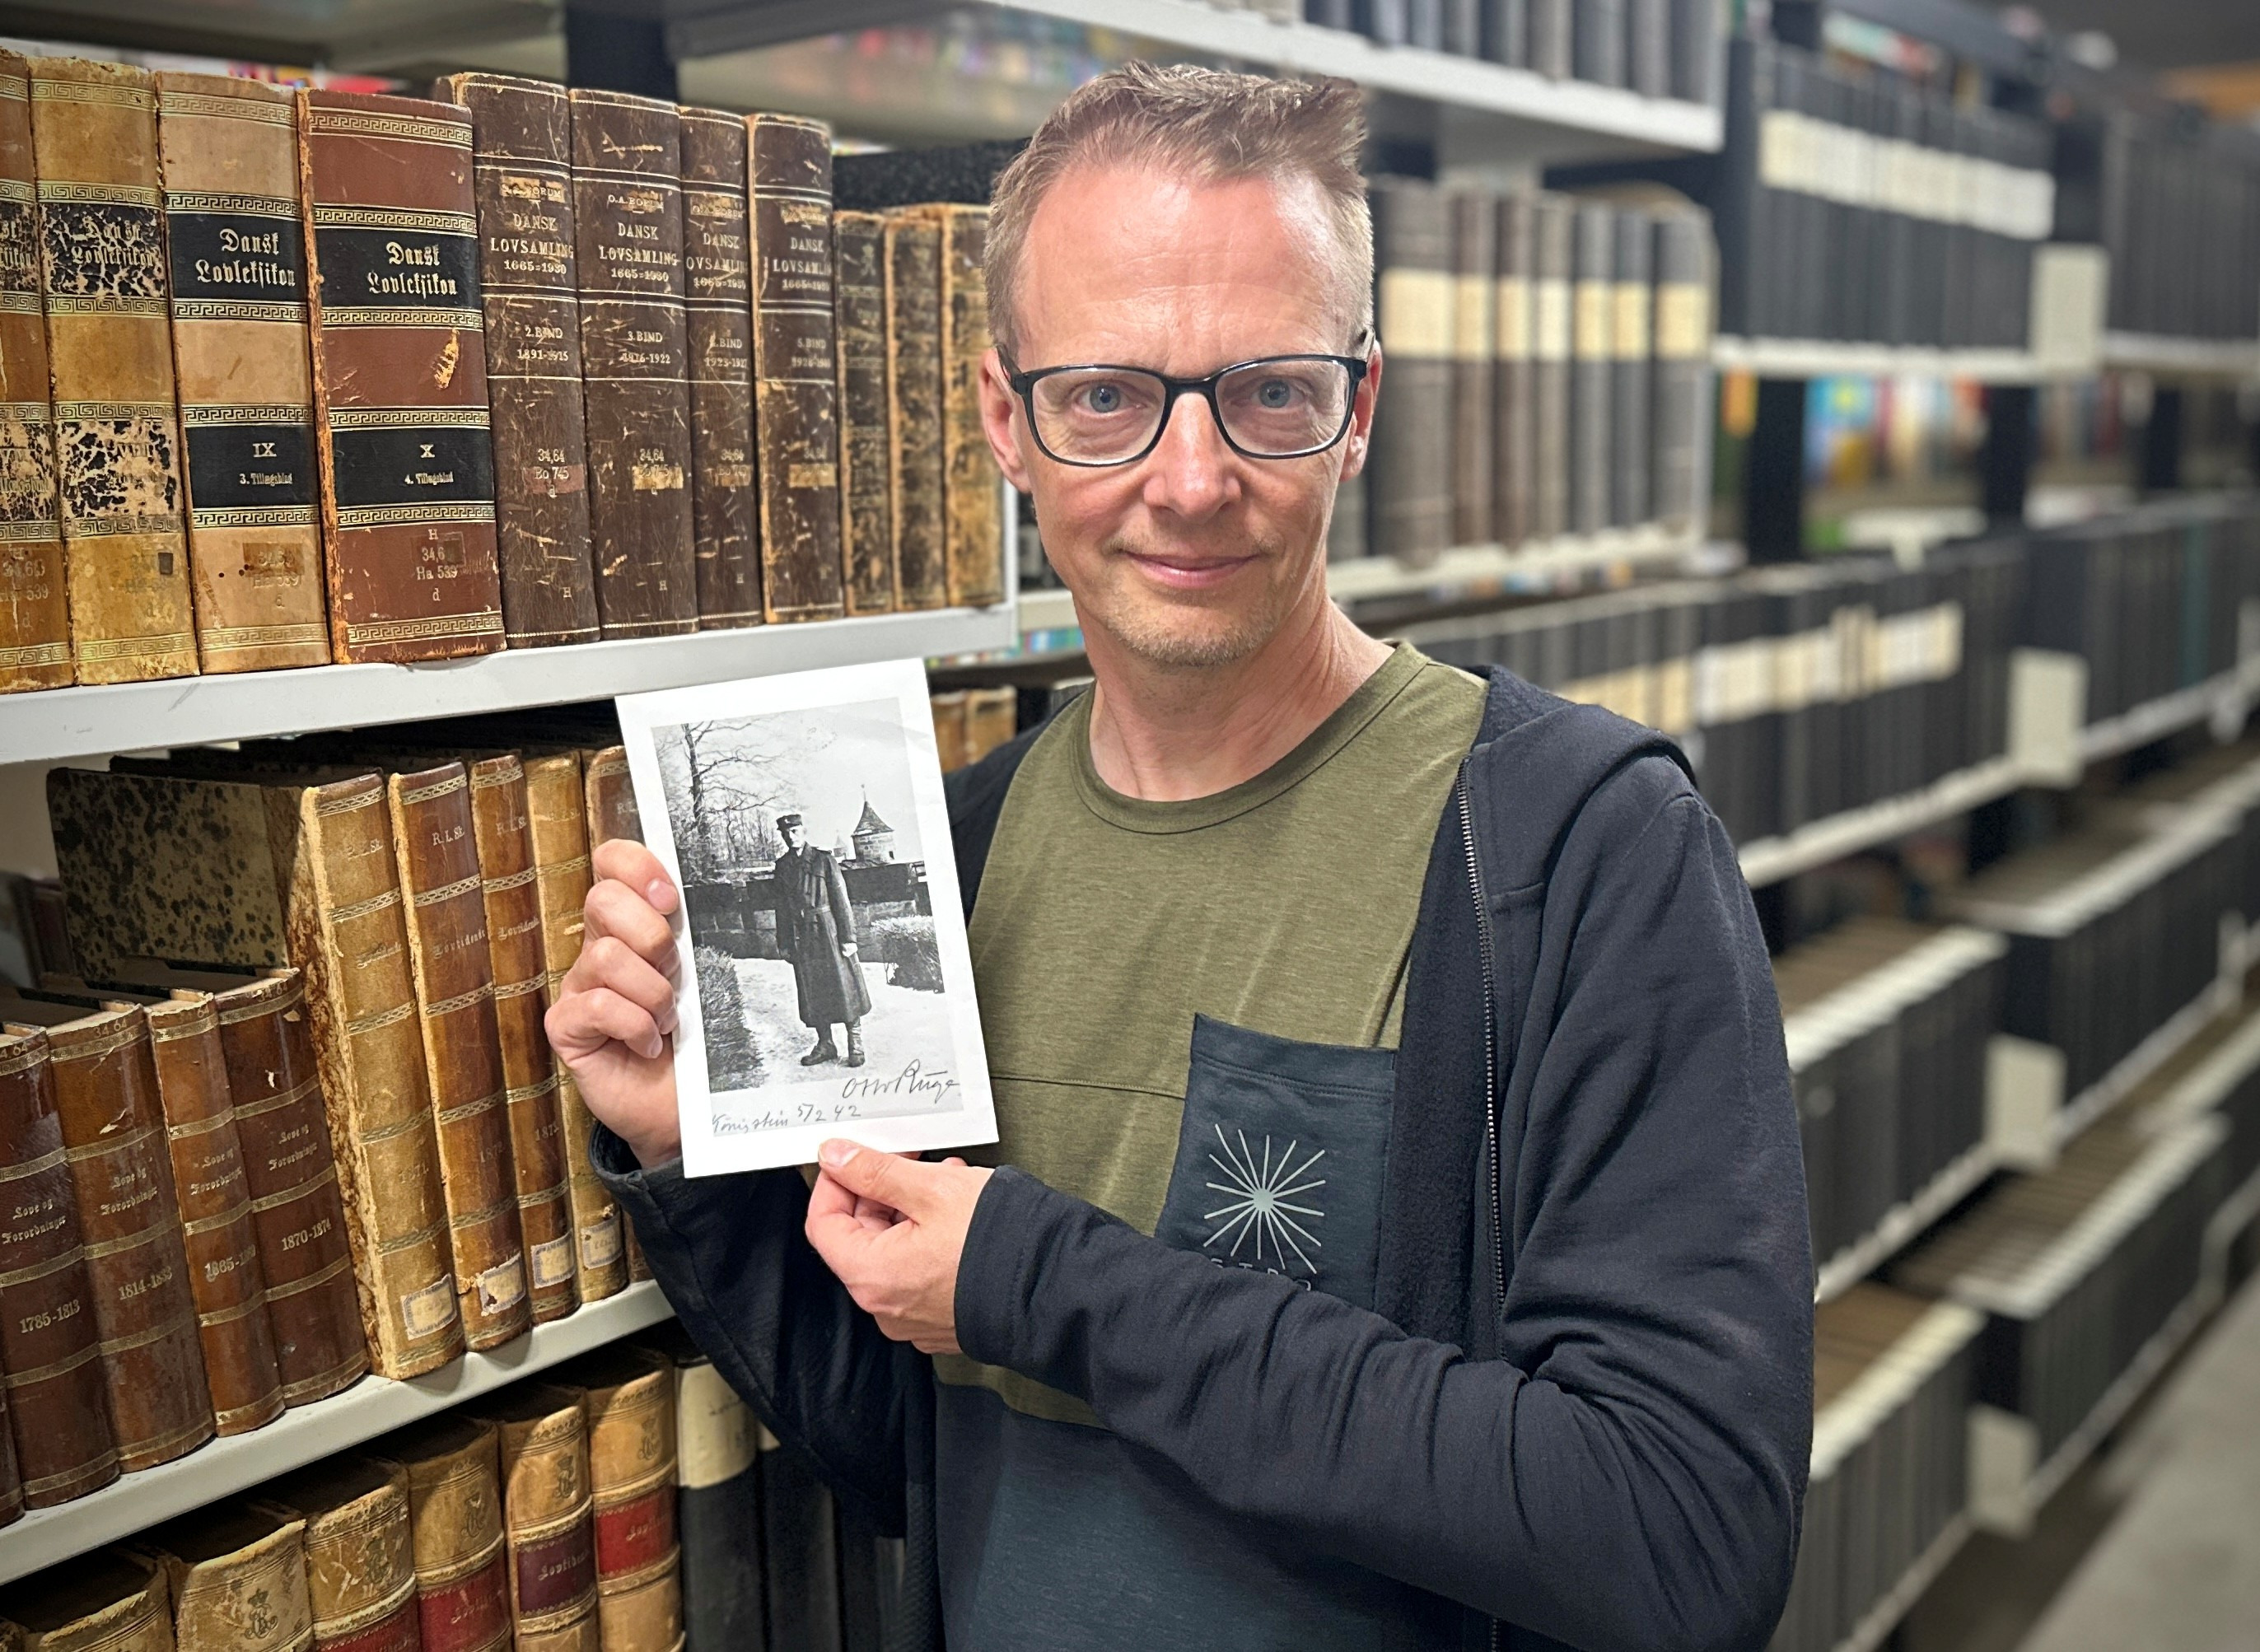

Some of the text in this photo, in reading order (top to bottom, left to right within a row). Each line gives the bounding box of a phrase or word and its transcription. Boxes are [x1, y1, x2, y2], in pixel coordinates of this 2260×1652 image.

[512, 212, 557, 231] DANSK
[618, 222, 658, 240] DANSK
[219, 228, 280, 255] Dansk
[703, 232, 740, 250] DANSK
[791, 236, 824, 253] DANSK
[385, 241, 441, 266] Dansk
[598, 245, 679, 267] LOVSAMLING
[773, 259, 831, 276] LOVSAMLIN
[253, 442, 277, 458] IX
[420, 444, 435, 458] X
[240, 474, 250, 485] 3.
[404, 474, 414, 485] 4.
[428, 529, 439, 540] H
[416, 564, 458, 580] Ha 539
[25, 583, 49, 601] 539
[432, 587, 441, 601] d
[563, 586, 572, 598] H
[20, 1299, 80, 1333] 1785-1813
